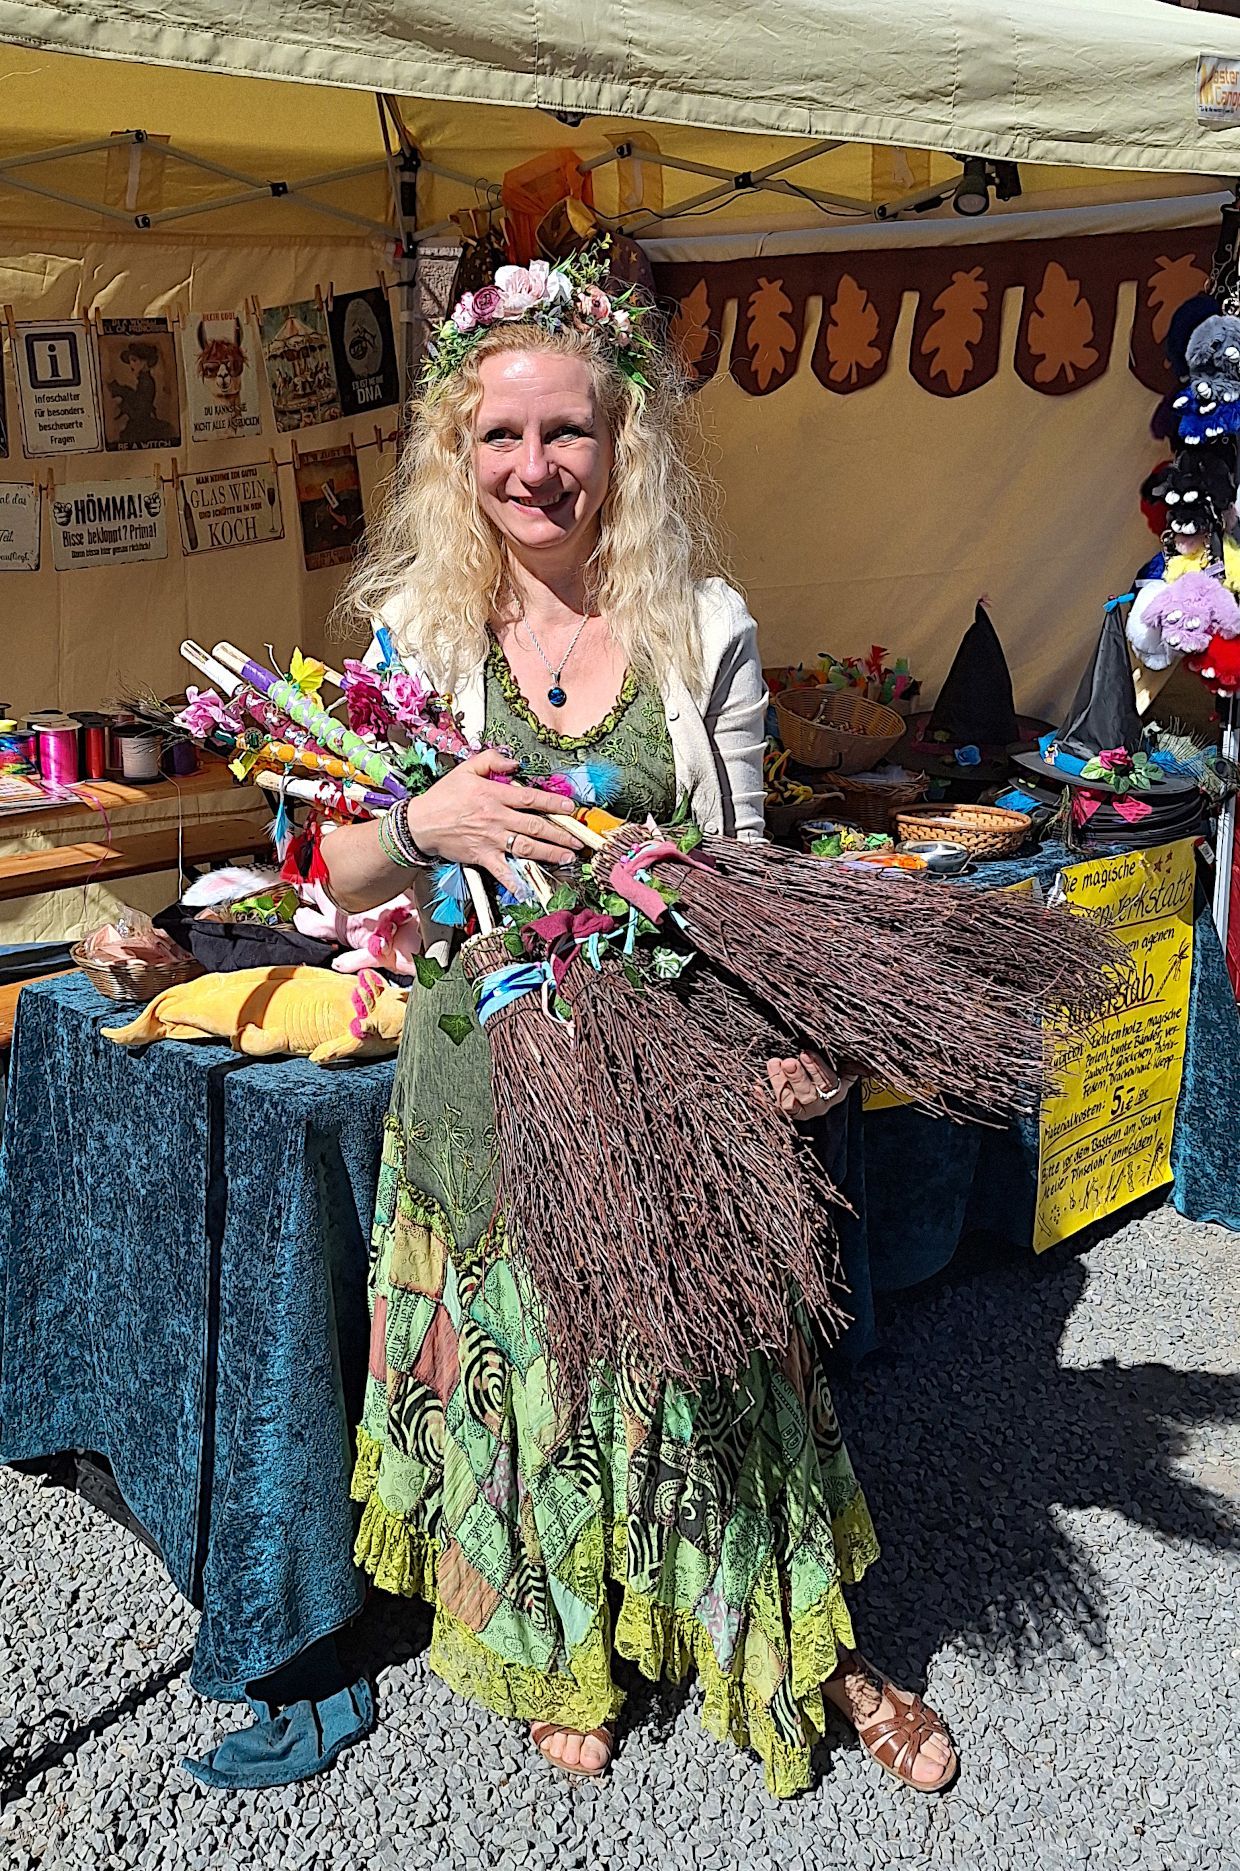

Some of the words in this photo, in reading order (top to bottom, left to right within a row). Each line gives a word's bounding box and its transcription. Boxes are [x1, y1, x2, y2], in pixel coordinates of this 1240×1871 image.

[34, 393, 81, 405] Infoschalter
[357, 385, 383, 404] DNA
[34, 408, 45, 418] für
[46, 406, 85, 417] besonders
[204, 405, 213, 416] DU
[38, 420, 84, 432] bescheuerte
[50, 435, 75, 446] Fragen
[190, 485, 226, 509] GLAS
[228, 479, 266, 503] WEIN
[73, 493, 144, 524] HÖMMA!
[62, 530, 85, 548] Bisse
[208, 516, 258, 547] KOCH
[1082, 859, 1136, 892] magische
[1141, 928, 1175, 956] eigenen
[1110, 1040, 1132, 1056] bunte
[1041, 1163, 1061, 1185] Bitte
[1073, 1145, 1090, 1163] dem
[1123, 1121, 1137, 1137] am
[1138, 1109, 1162, 1131] Stand
